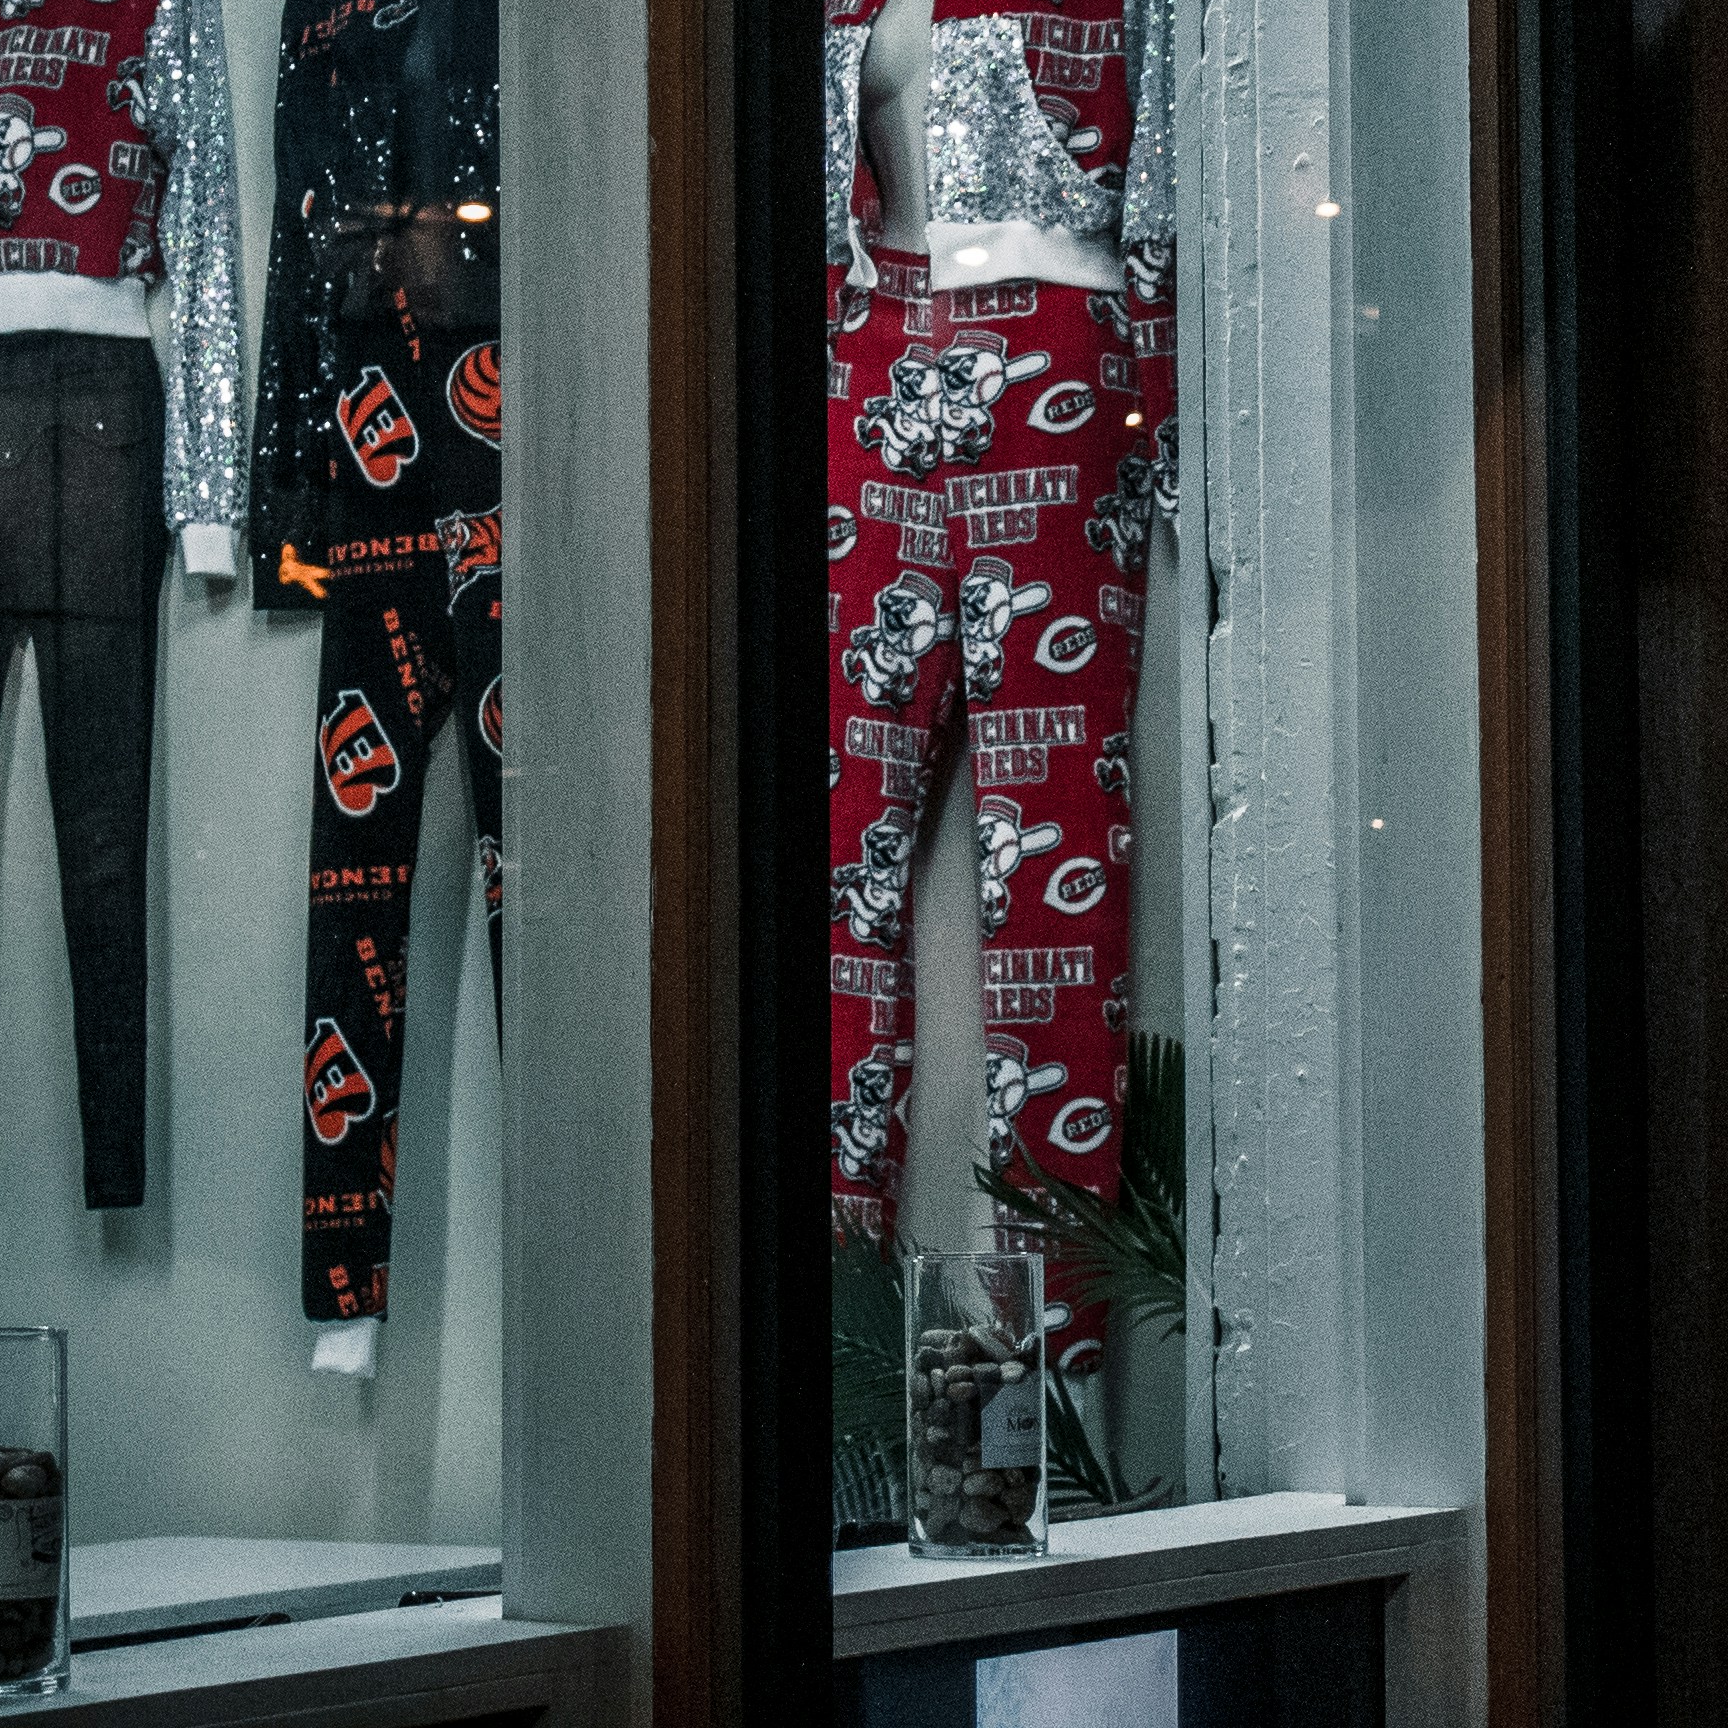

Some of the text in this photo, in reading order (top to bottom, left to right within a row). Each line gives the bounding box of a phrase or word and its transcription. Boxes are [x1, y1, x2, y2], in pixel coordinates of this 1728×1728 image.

[1036, 51, 1105, 91] REDS
[967, 504, 1039, 549] REDS
[976, 744, 1050, 788] REDS
